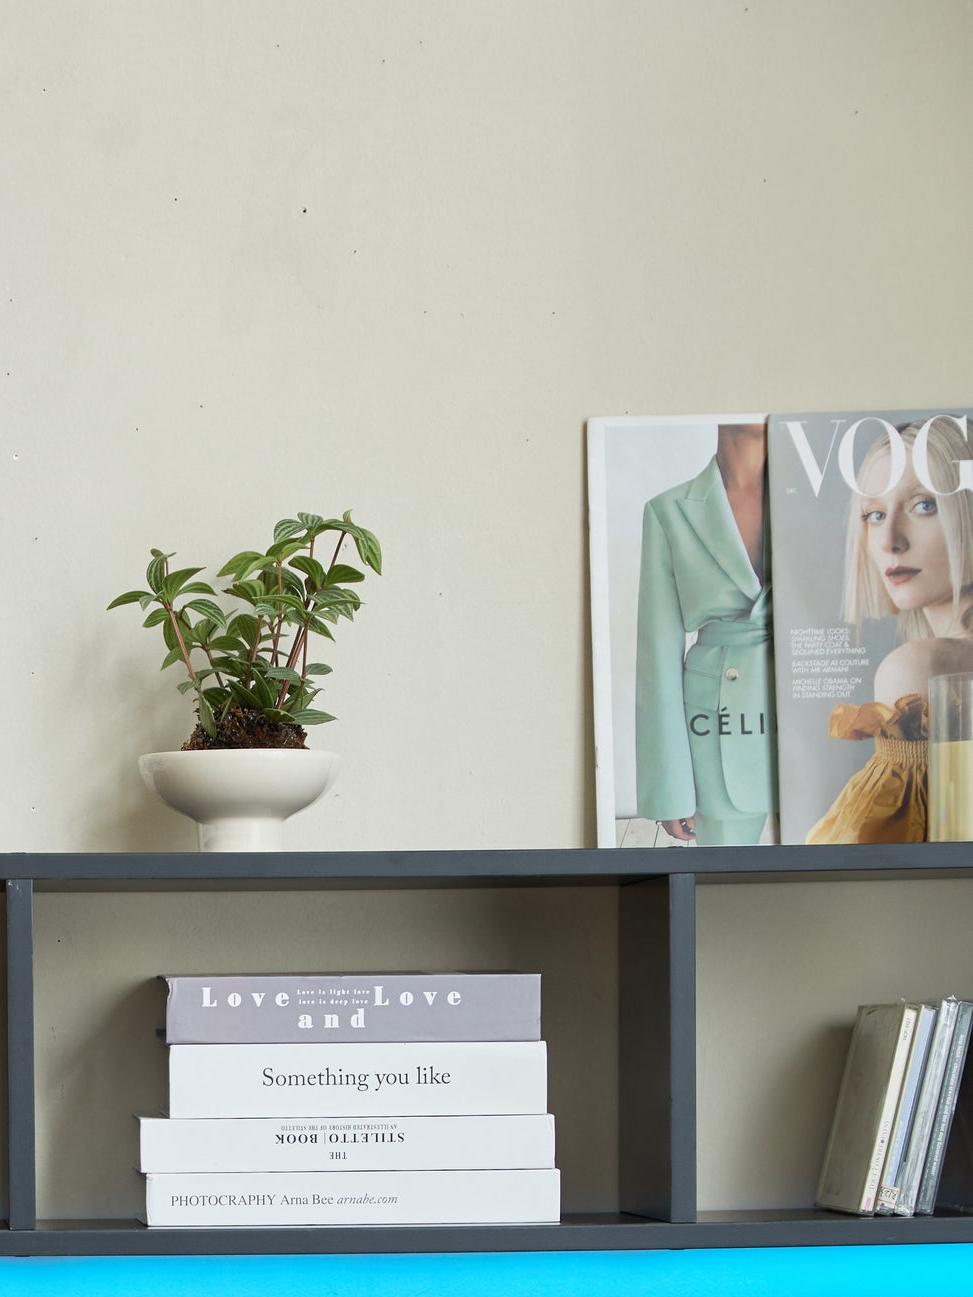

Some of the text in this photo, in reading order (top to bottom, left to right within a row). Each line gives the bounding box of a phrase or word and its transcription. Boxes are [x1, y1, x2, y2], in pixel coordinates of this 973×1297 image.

[827, 647, 866, 655] EVERYTHING
[689, 707, 779, 736] CÉLI
[202, 986, 461, 1007] Love Love
[298, 1008, 365, 1028] and
[263, 1066, 450, 1091] Something you like
[276, 1133, 404, 1144] STILETTO BOOK
[281, 1195, 308, 1205] Arna
[313, 1194, 333, 1204] Bee
[337, 1193, 397, 1204] arnabe.com
